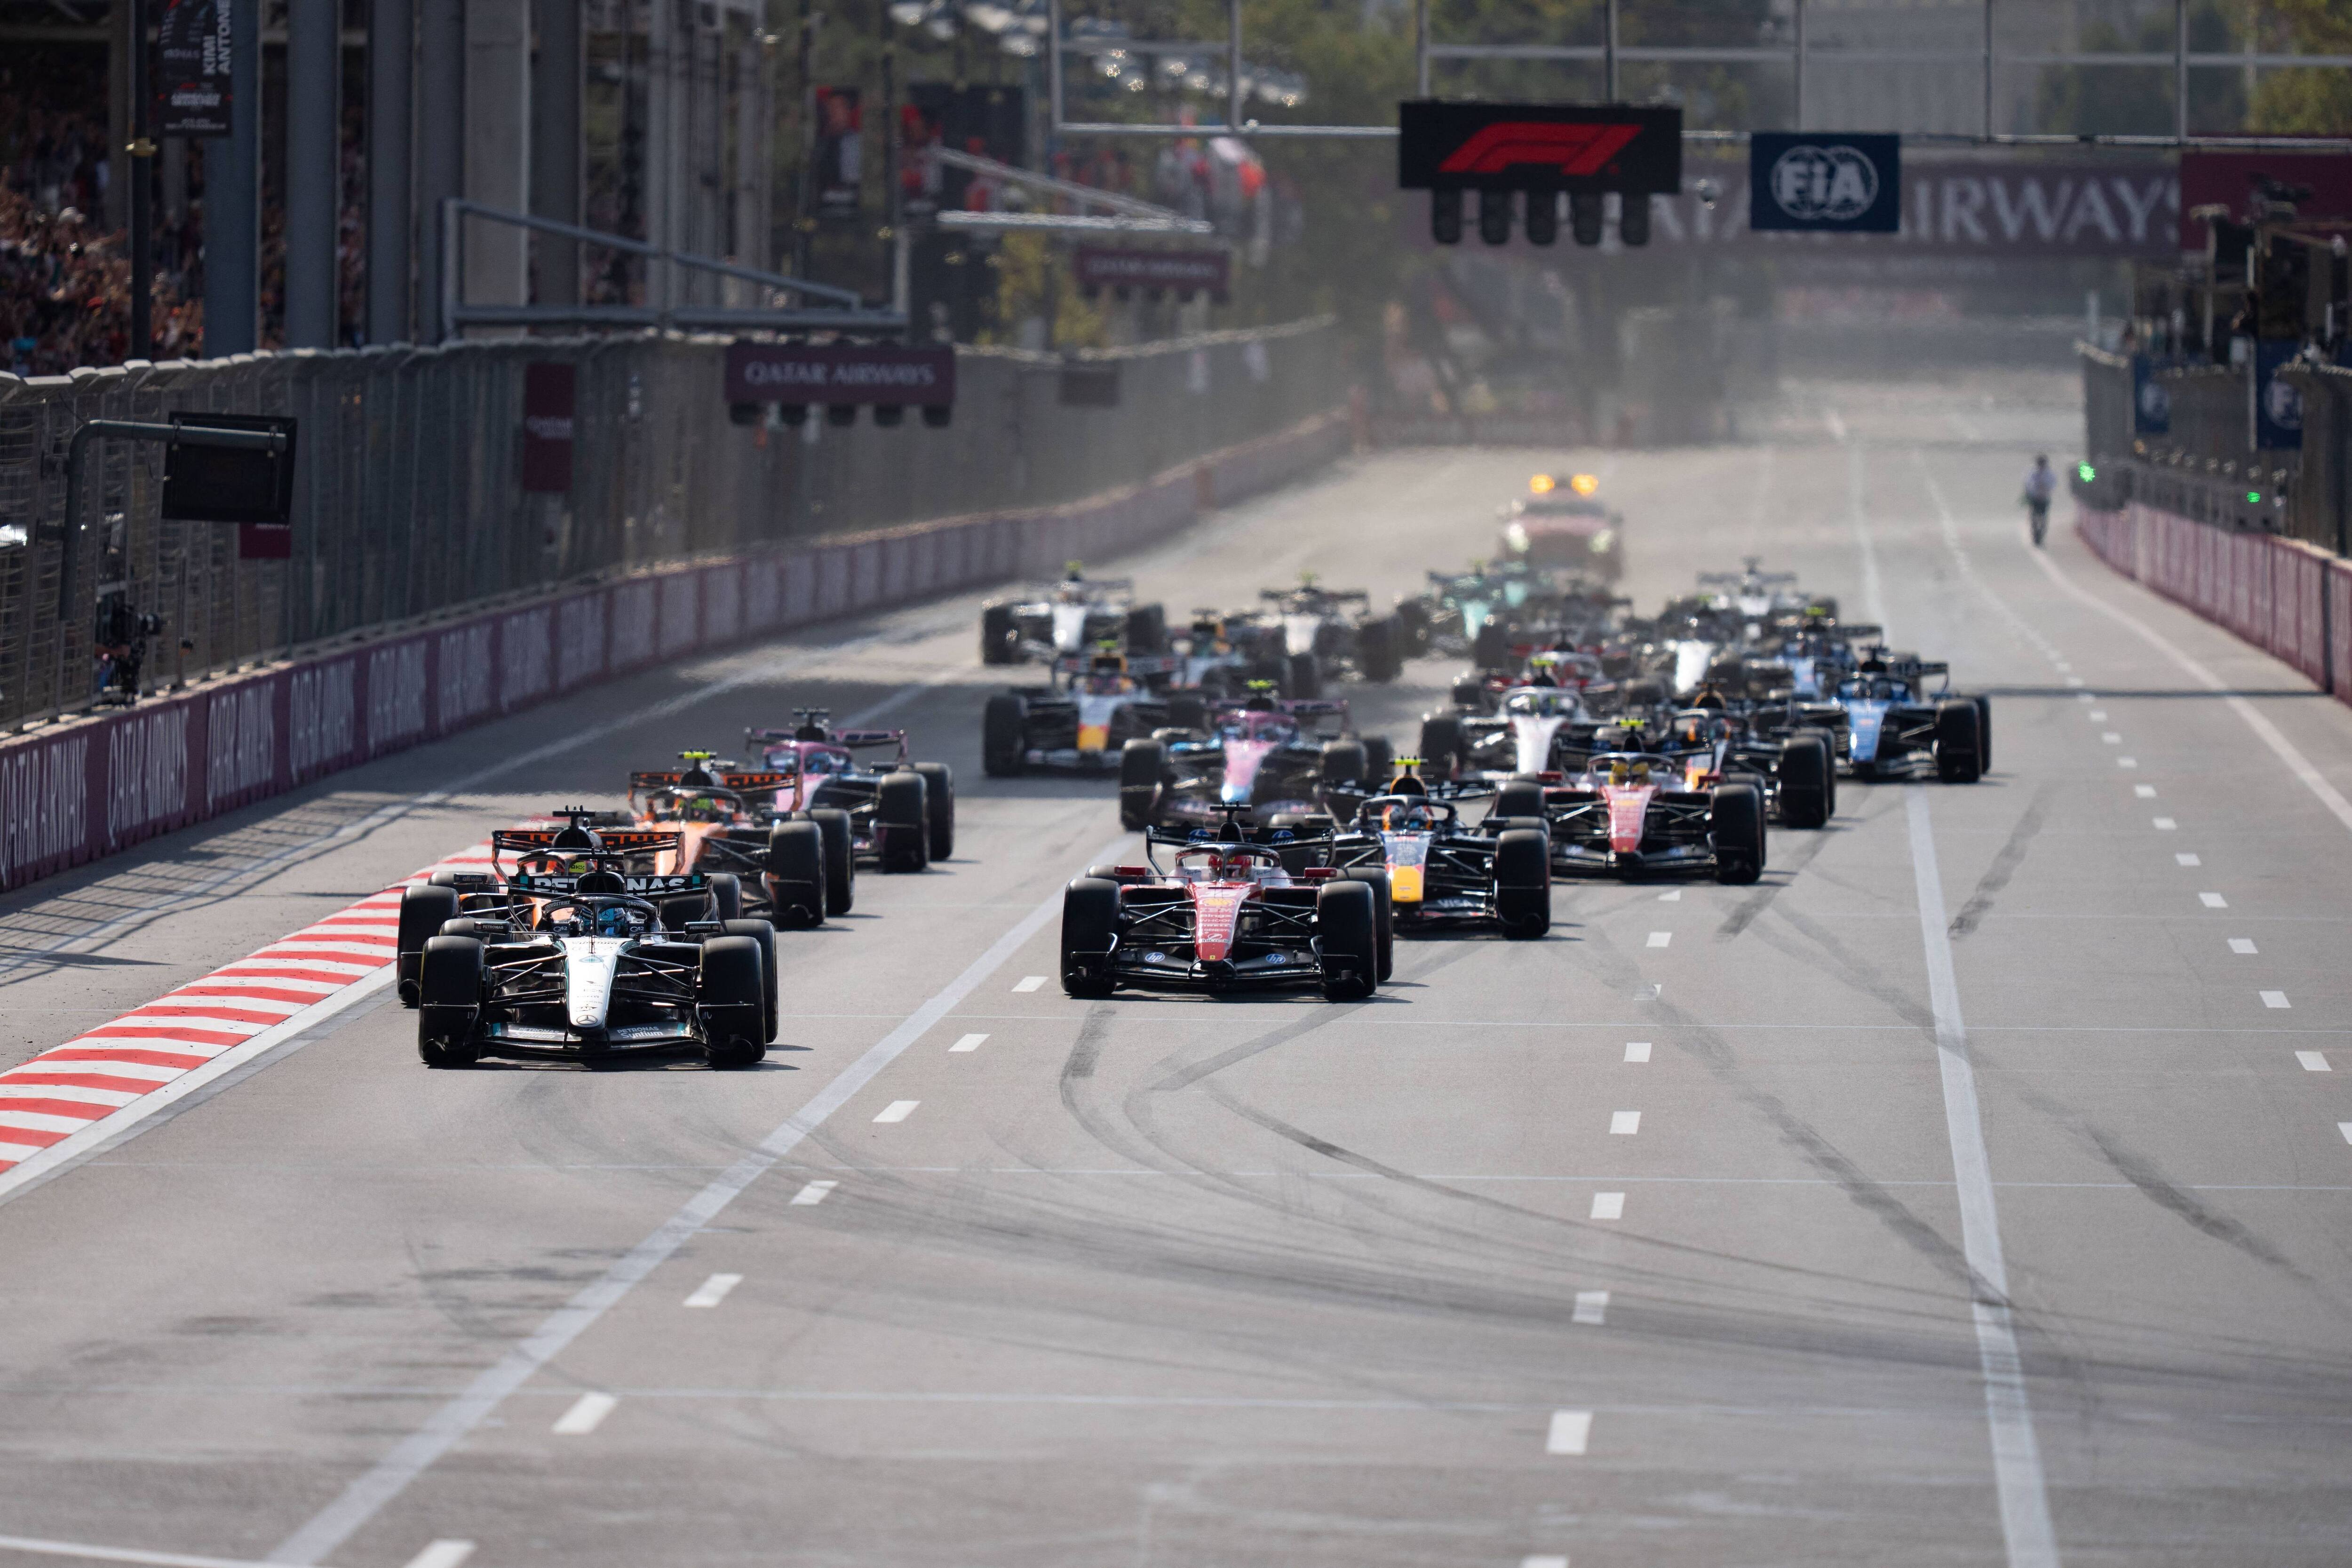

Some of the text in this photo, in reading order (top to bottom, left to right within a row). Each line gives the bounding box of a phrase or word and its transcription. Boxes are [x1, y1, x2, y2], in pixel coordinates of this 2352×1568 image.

[203, 35, 216, 75] KIMI
[1438, 121, 1644, 176] F1
[745, 361, 936, 385] QATAR AIRWAYS
[620, 1030, 664, 1039] Syntium
